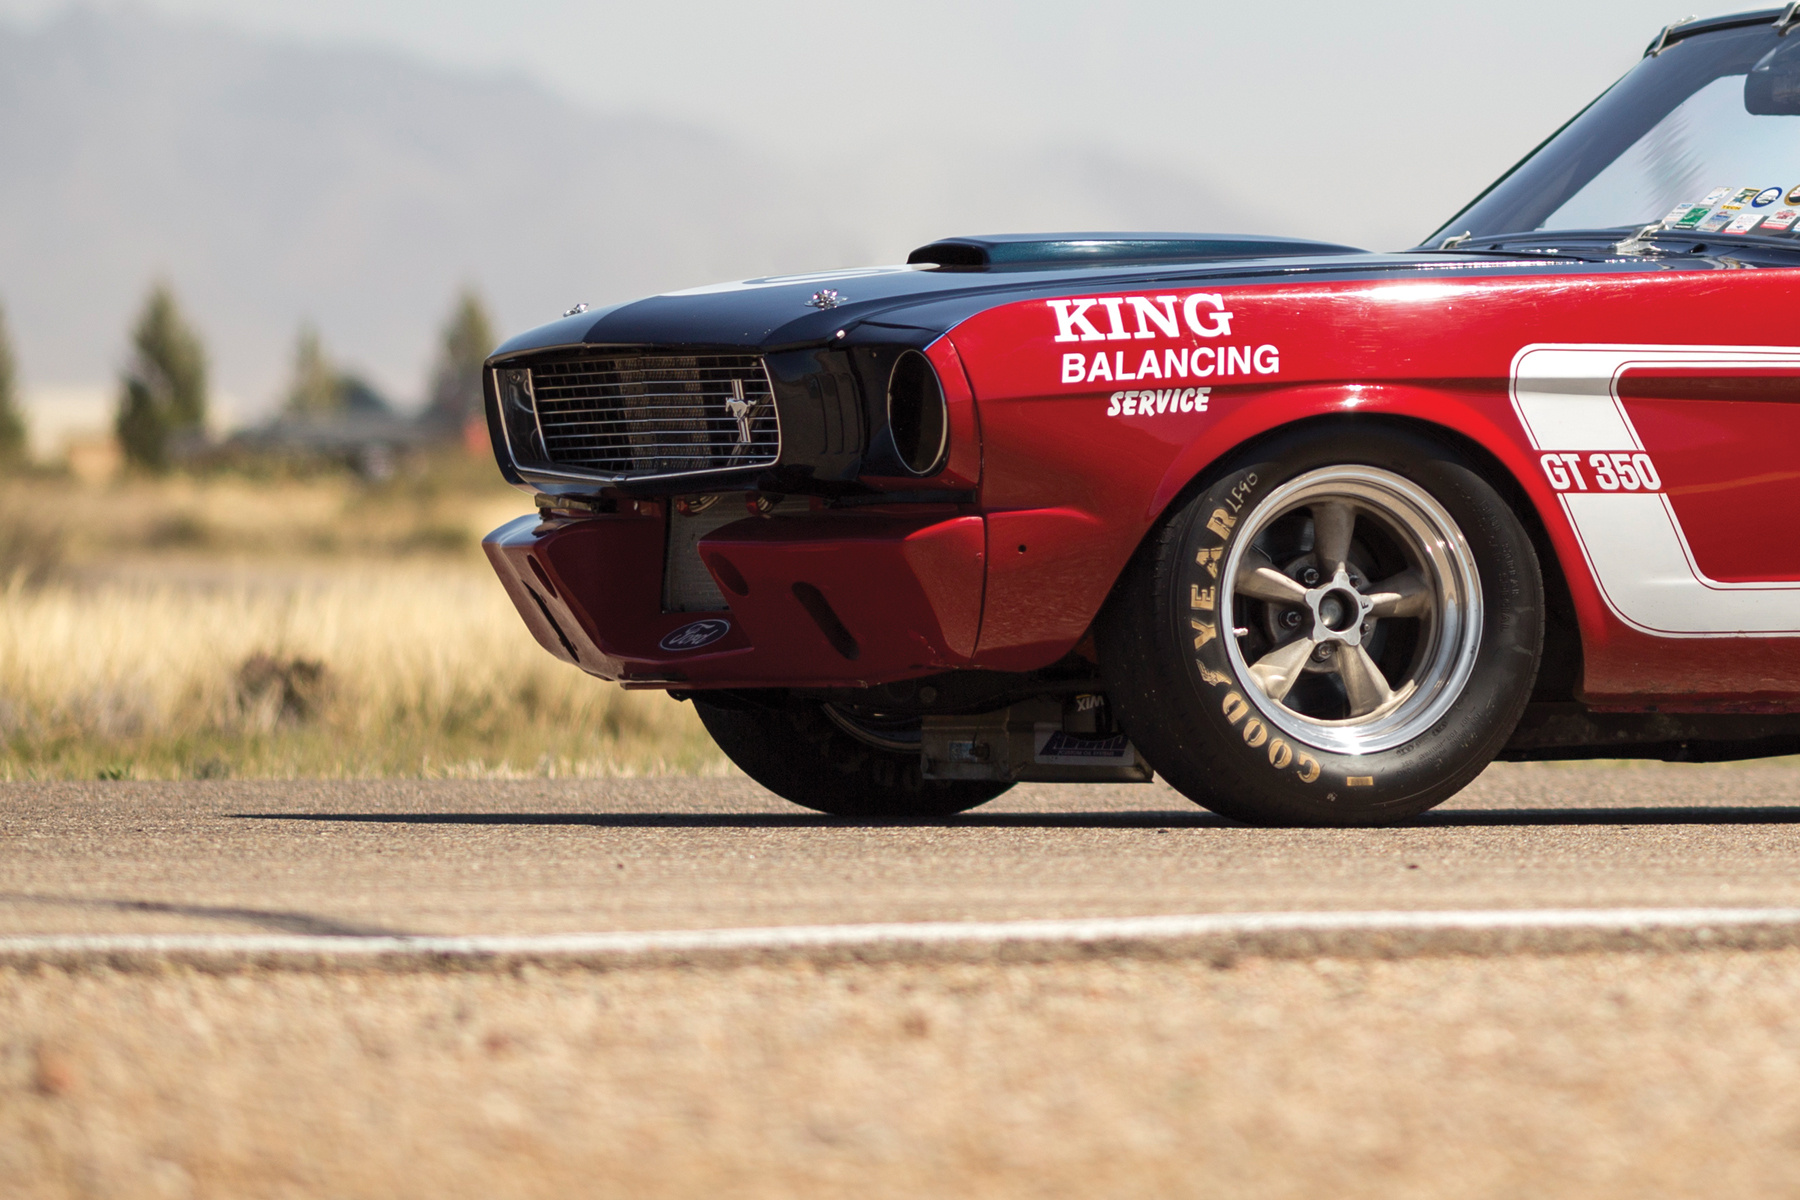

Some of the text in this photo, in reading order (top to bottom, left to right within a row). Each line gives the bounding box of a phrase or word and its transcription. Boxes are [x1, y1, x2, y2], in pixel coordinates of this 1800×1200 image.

[1046, 293, 1234, 342] KING
[1061, 344, 1280, 383] BALANCING
[1107, 387, 1212, 417] SERVICE
[1540, 453, 1662, 490] GT 350
[668, 623, 718, 645] Ford
[1076, 695, 1104, 712] WIX
